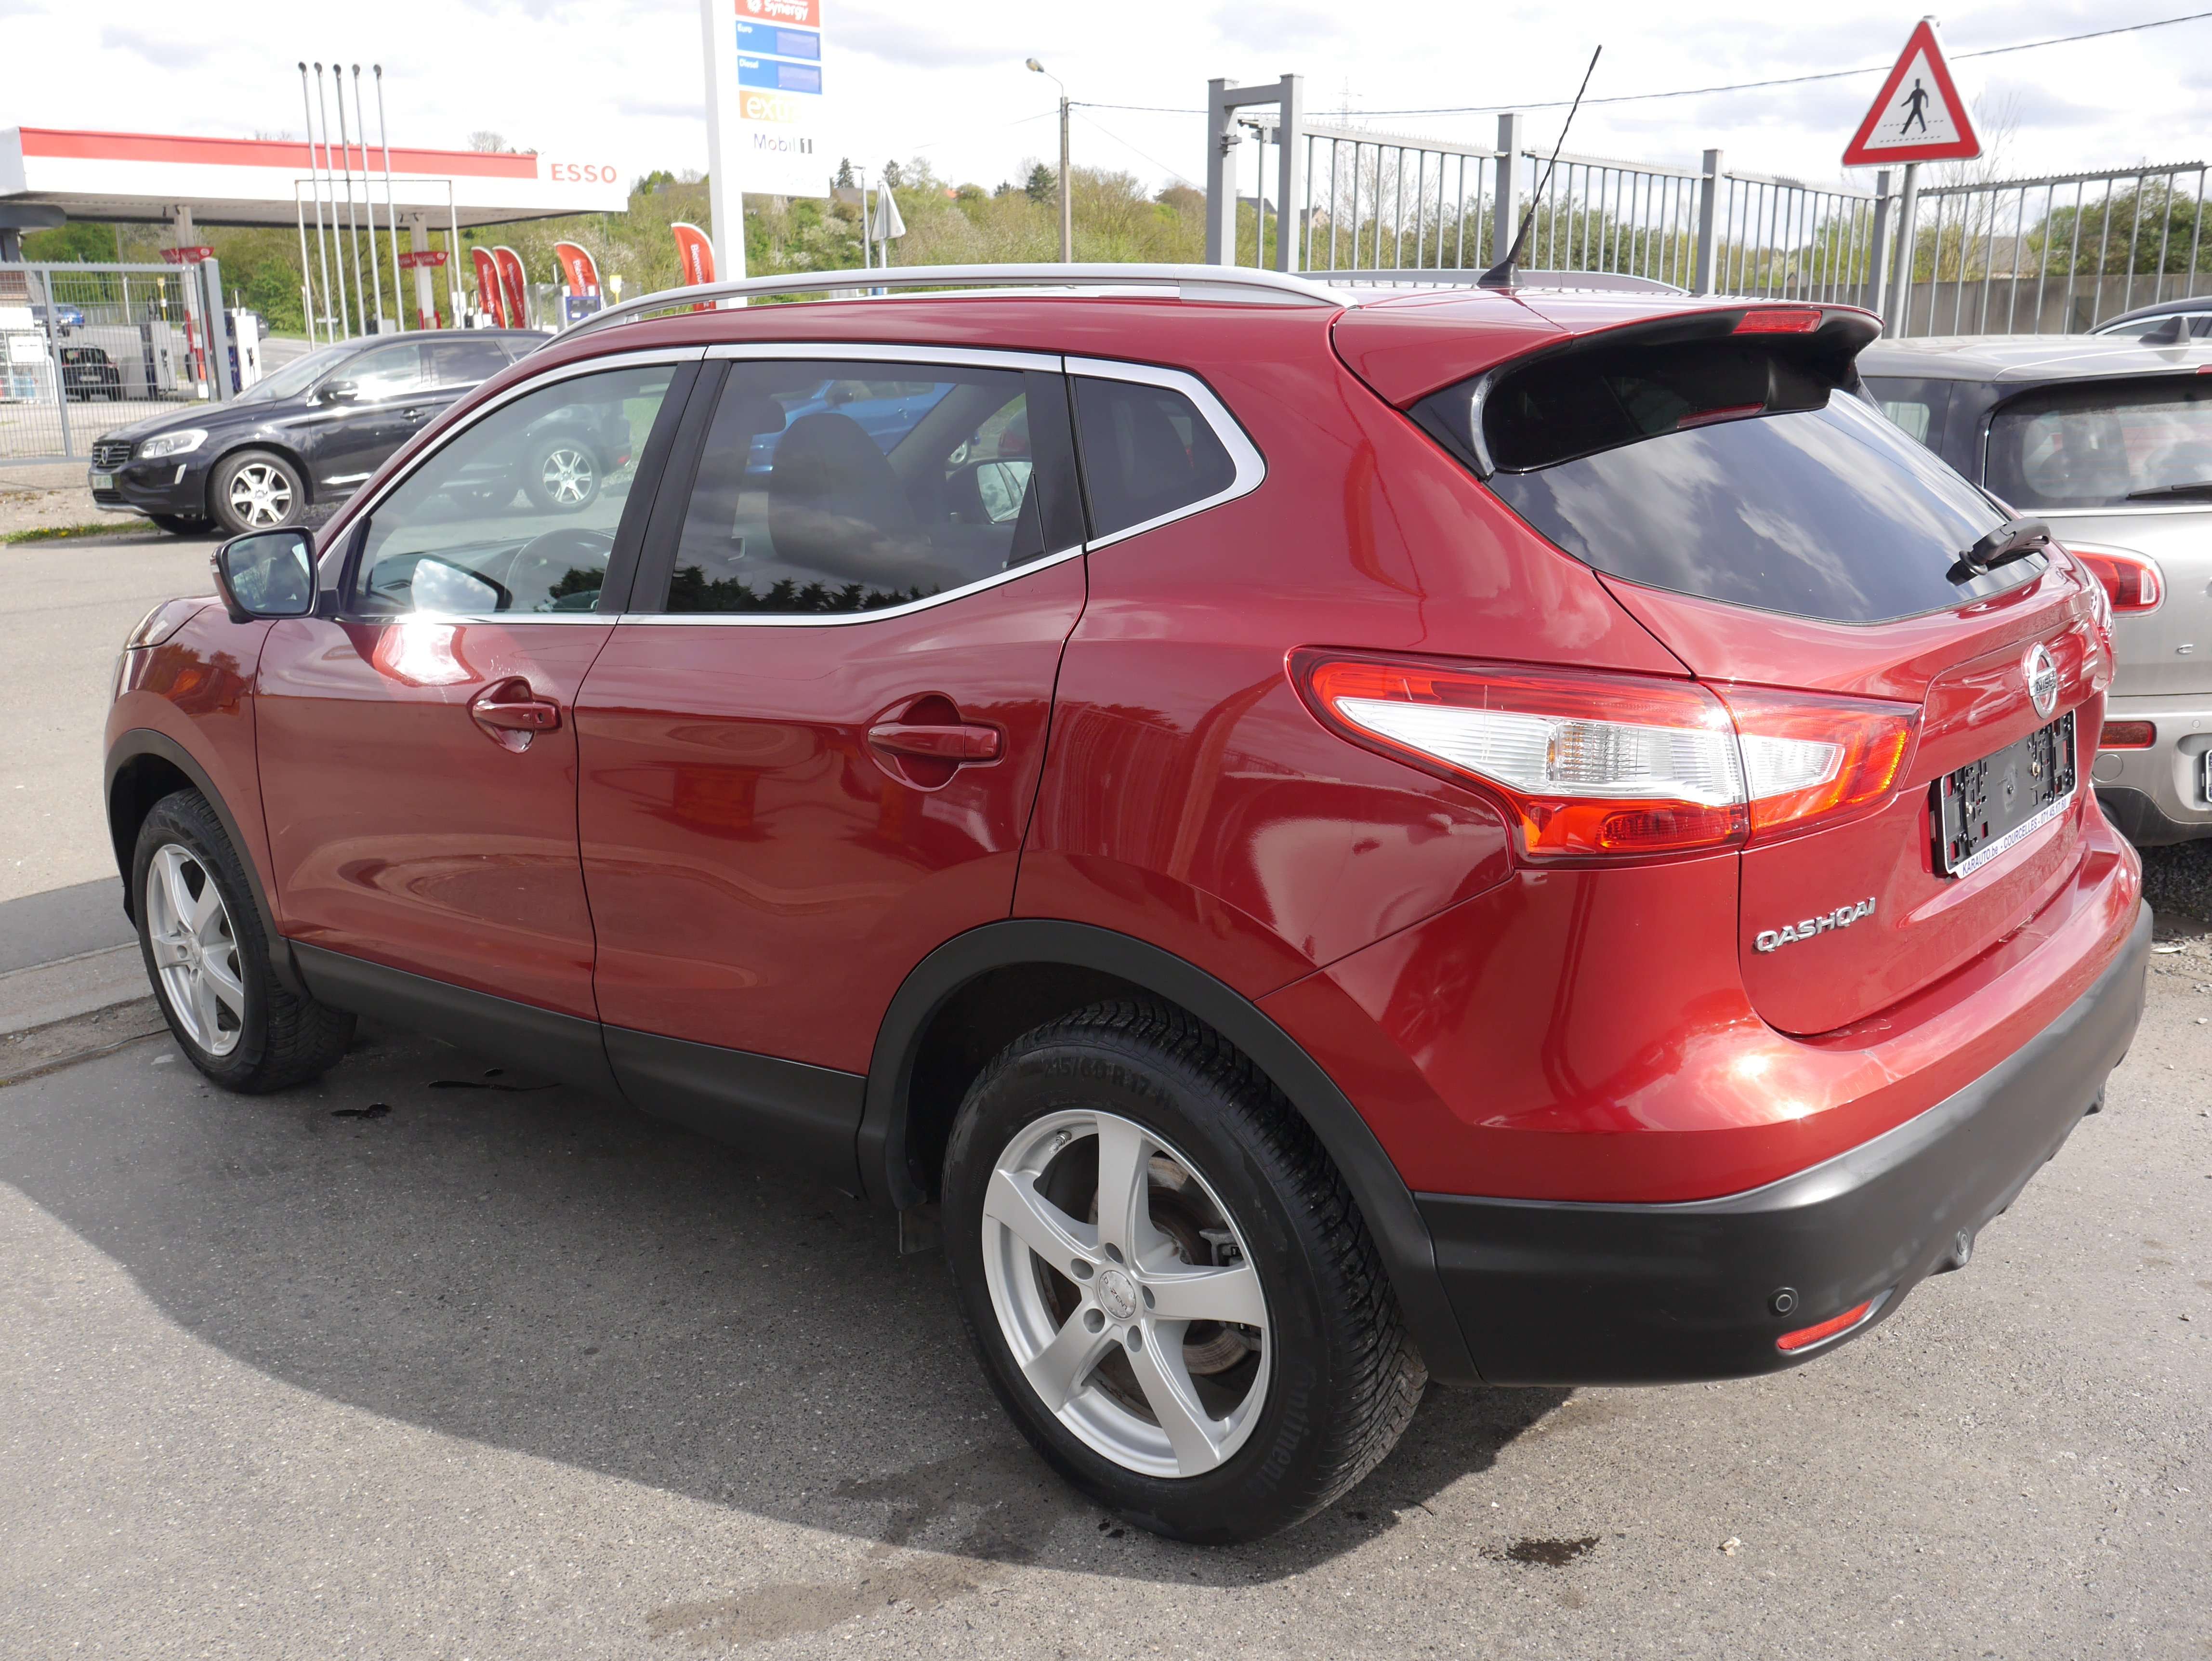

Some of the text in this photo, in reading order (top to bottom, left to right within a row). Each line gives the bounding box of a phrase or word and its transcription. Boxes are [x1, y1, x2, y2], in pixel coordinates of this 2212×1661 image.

[764, 0, 808, 21] Synergy
[754, 133, 796, 152] Mobil
[551, 163, 617, 184] ESSO
[1962, 846, 1998, 876] KARAUTO.be
[2003, 818, 2038, 849] COURCELLES
[1754, 896, 1875, 952] QASHQAI
